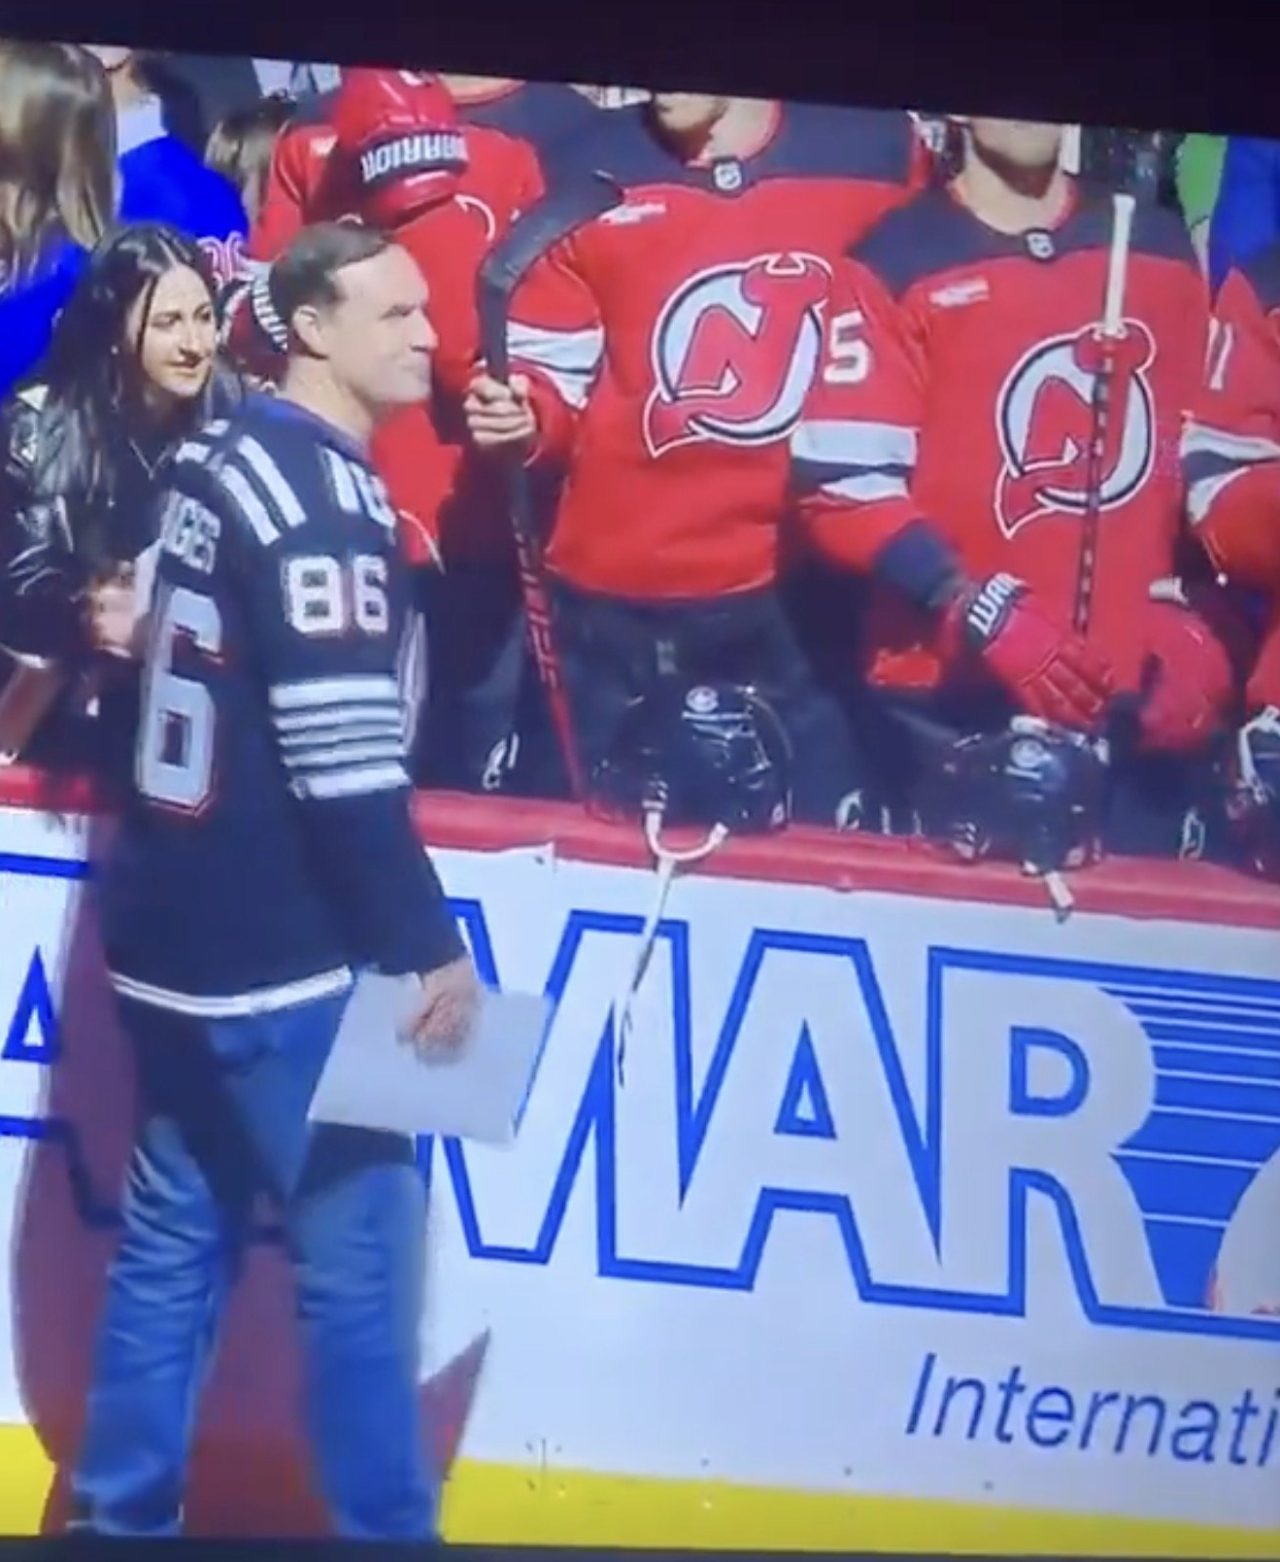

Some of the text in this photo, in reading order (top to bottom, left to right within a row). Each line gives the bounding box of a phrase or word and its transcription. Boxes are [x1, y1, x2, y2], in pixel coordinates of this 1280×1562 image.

[823, 310, 871, 385] 5
[279, 553, 389, 637] 86
[905, 1351, 1280, 1467] Internati
